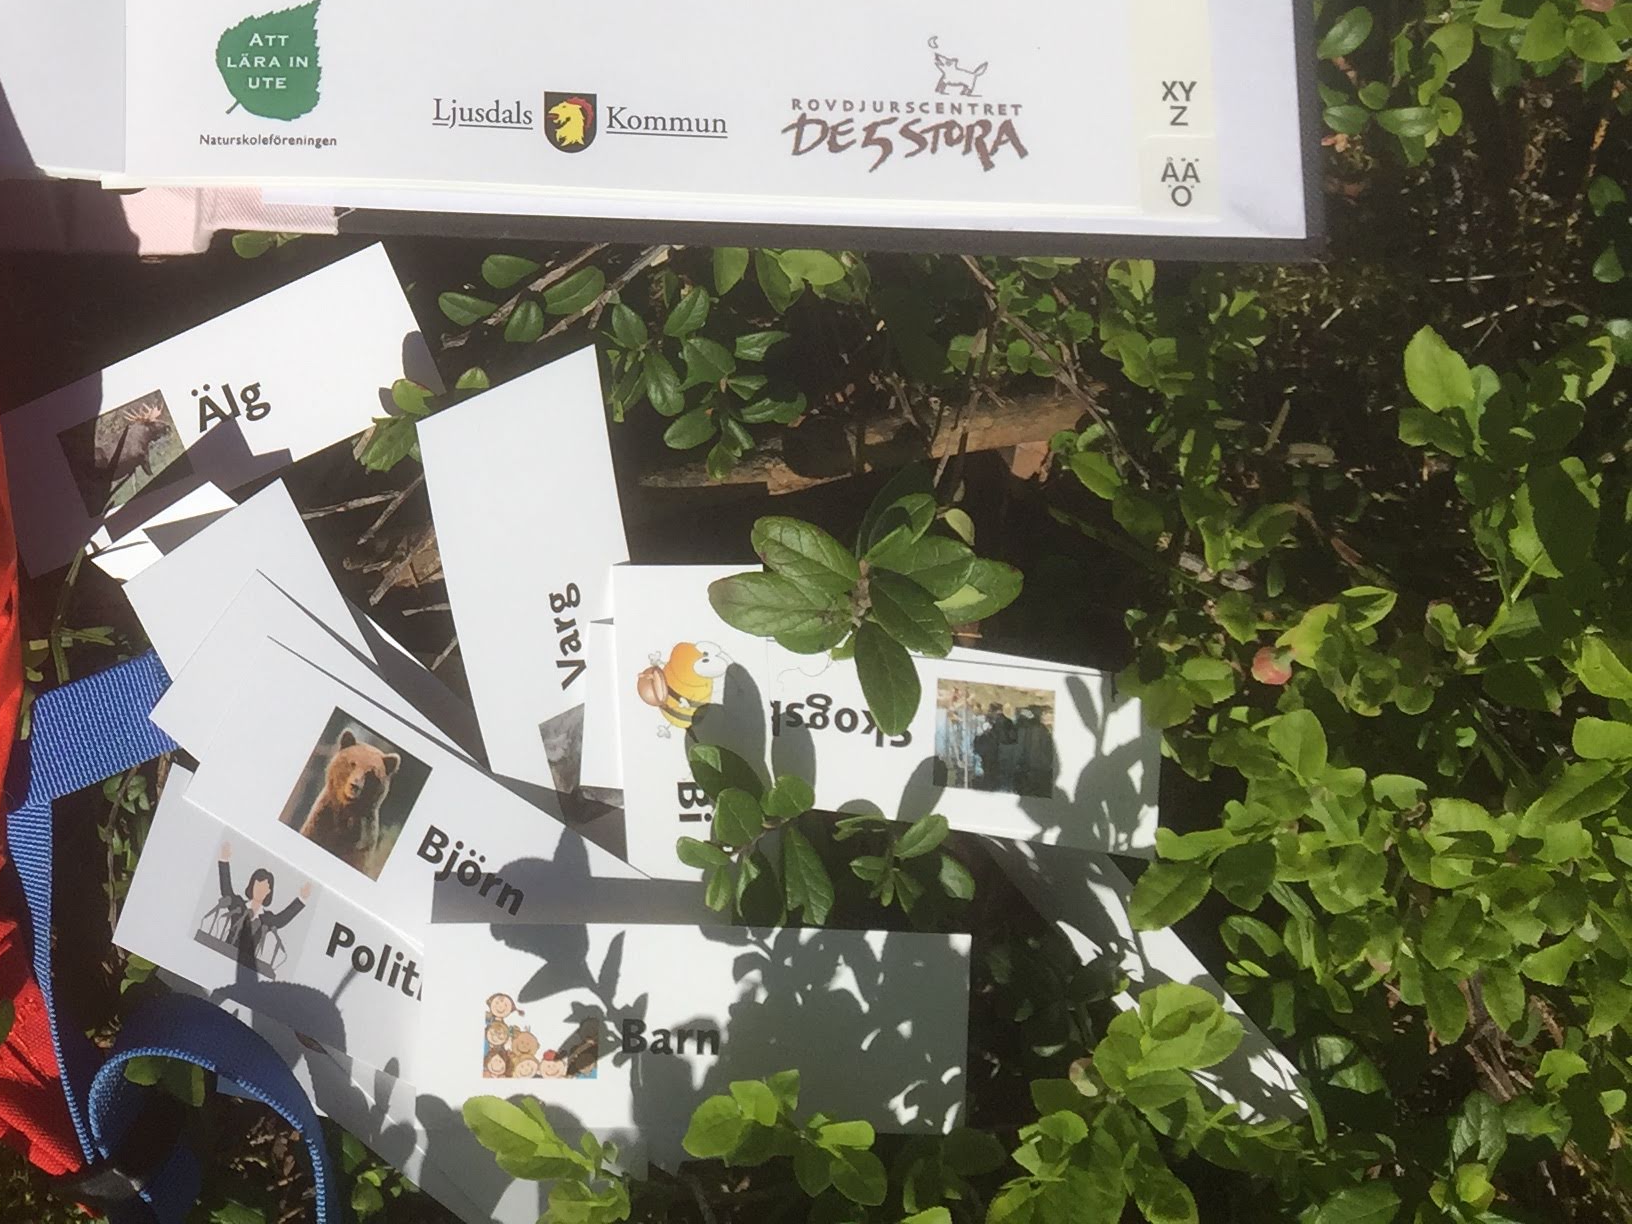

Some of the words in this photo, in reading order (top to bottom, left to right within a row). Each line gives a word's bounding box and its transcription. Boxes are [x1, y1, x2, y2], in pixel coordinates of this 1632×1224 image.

[249, 32, 290, 47] ATT
[226, 53, 281, 68] LÄRA
[289, 55, 309, 68] IN
[248, 77, 287, 89] UTE
[1161, 80, 1198, 102] XY
[432, 97, 534, 129] Ljusdals
[605, 105, 728, 134] Kommun
[791, 98, 1023, 117] ROVDJURSCENTRET
[1169, 105, 1189, 126] Z
[199, 133, 337, 149] Naturskoleföreningen
[781, 112, 857, 156] DE
[899, 117, 1029, 172] STORA
[1160, 156, 1201, 184] ÅÄ
[1167, 184, 1195, 207] Ö
[190, 381, 272, 434] Älg
[548, 582, 587, 691] Varg
[676, 781, 713, 823] Bi
[416, 824, 525, 917] Björn
[325, 921, 423, 1002] Polit
[621, 1018, 721, 1056] Barn
